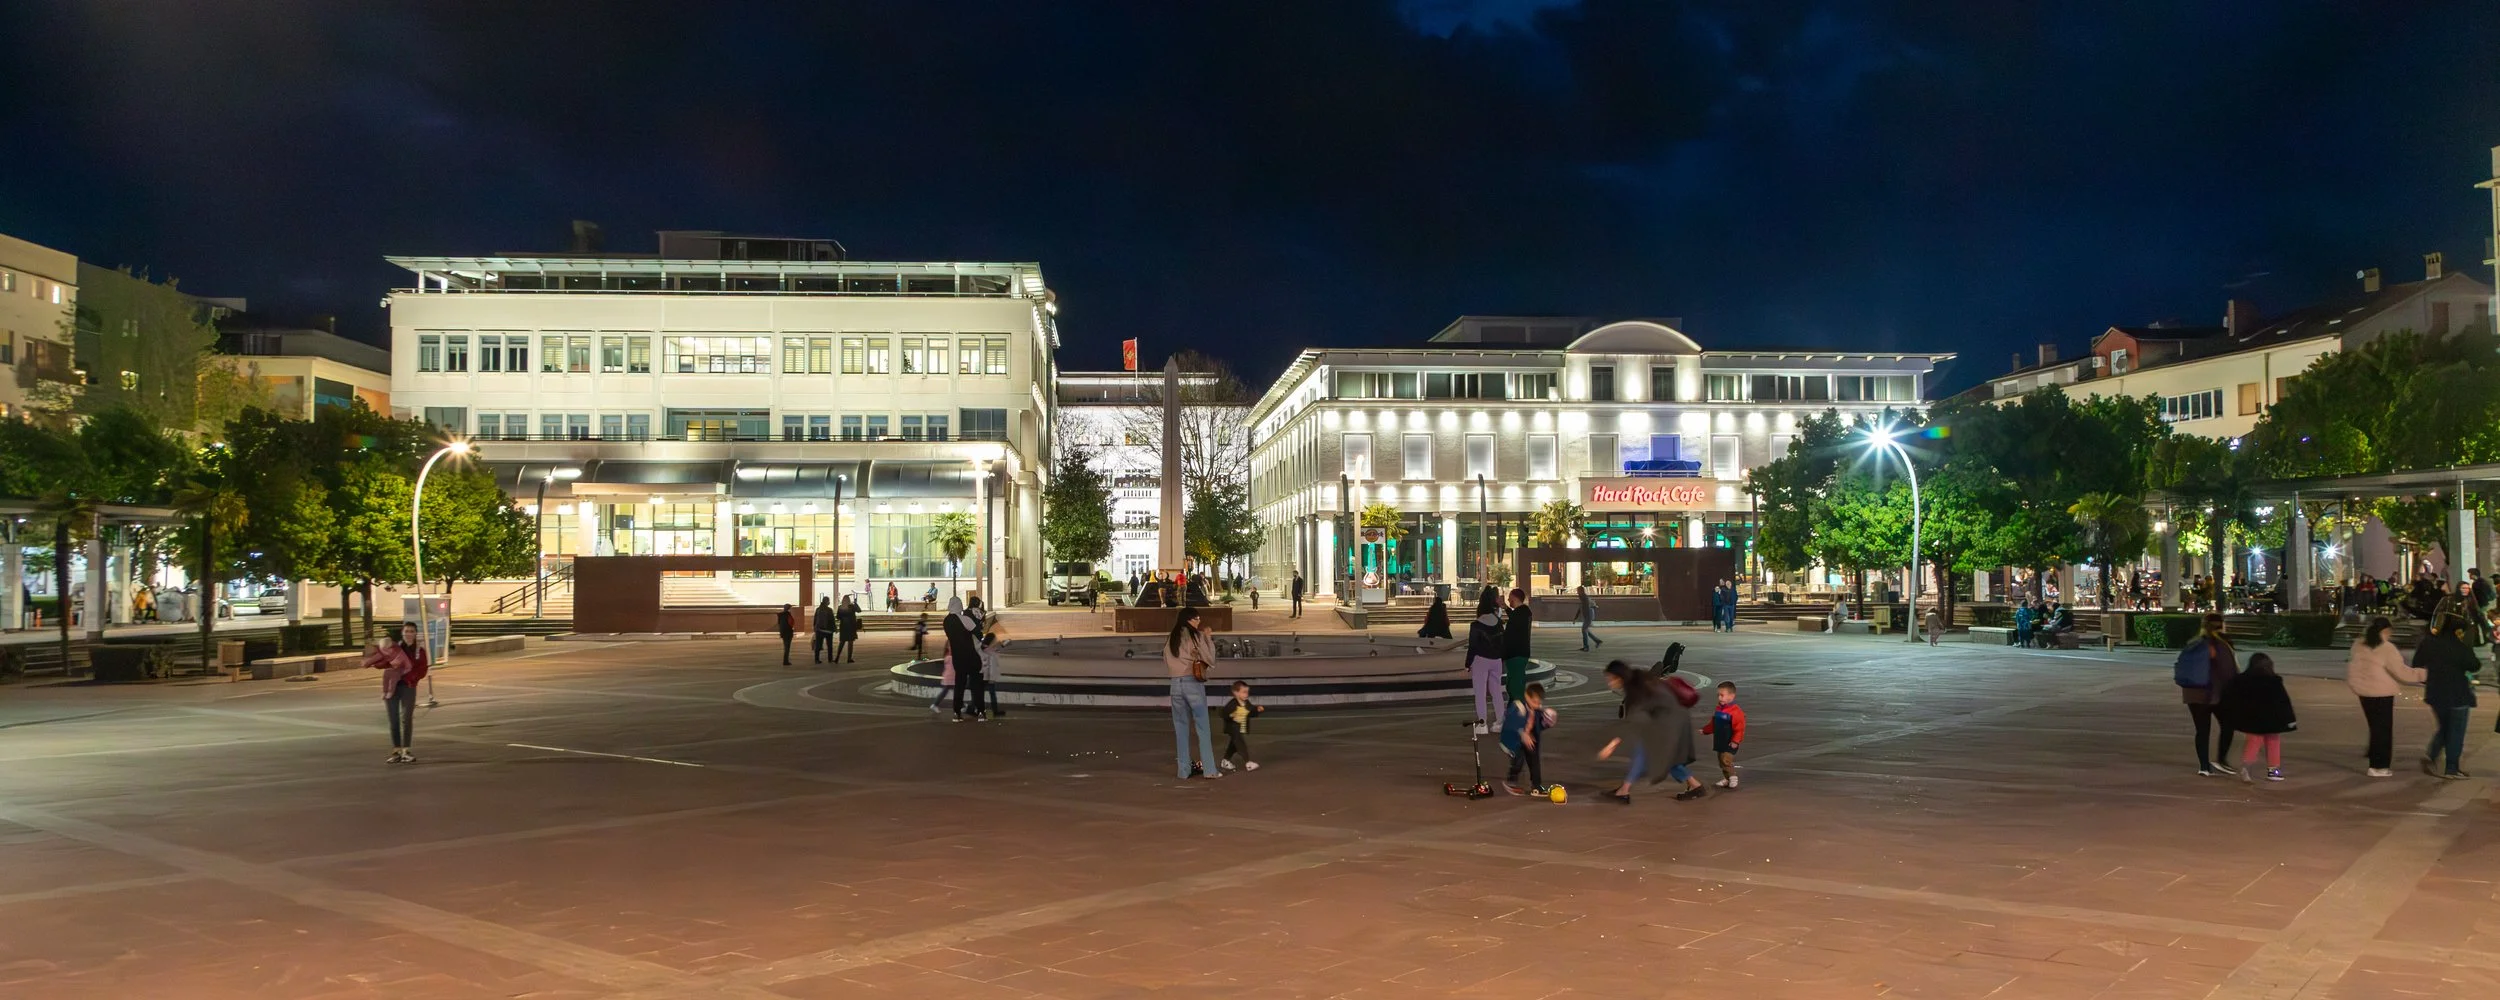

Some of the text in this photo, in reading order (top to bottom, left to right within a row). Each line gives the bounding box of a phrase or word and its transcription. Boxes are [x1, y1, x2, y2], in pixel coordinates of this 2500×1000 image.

[1593, 485, 1705, 505] Hard Rock Cafe
